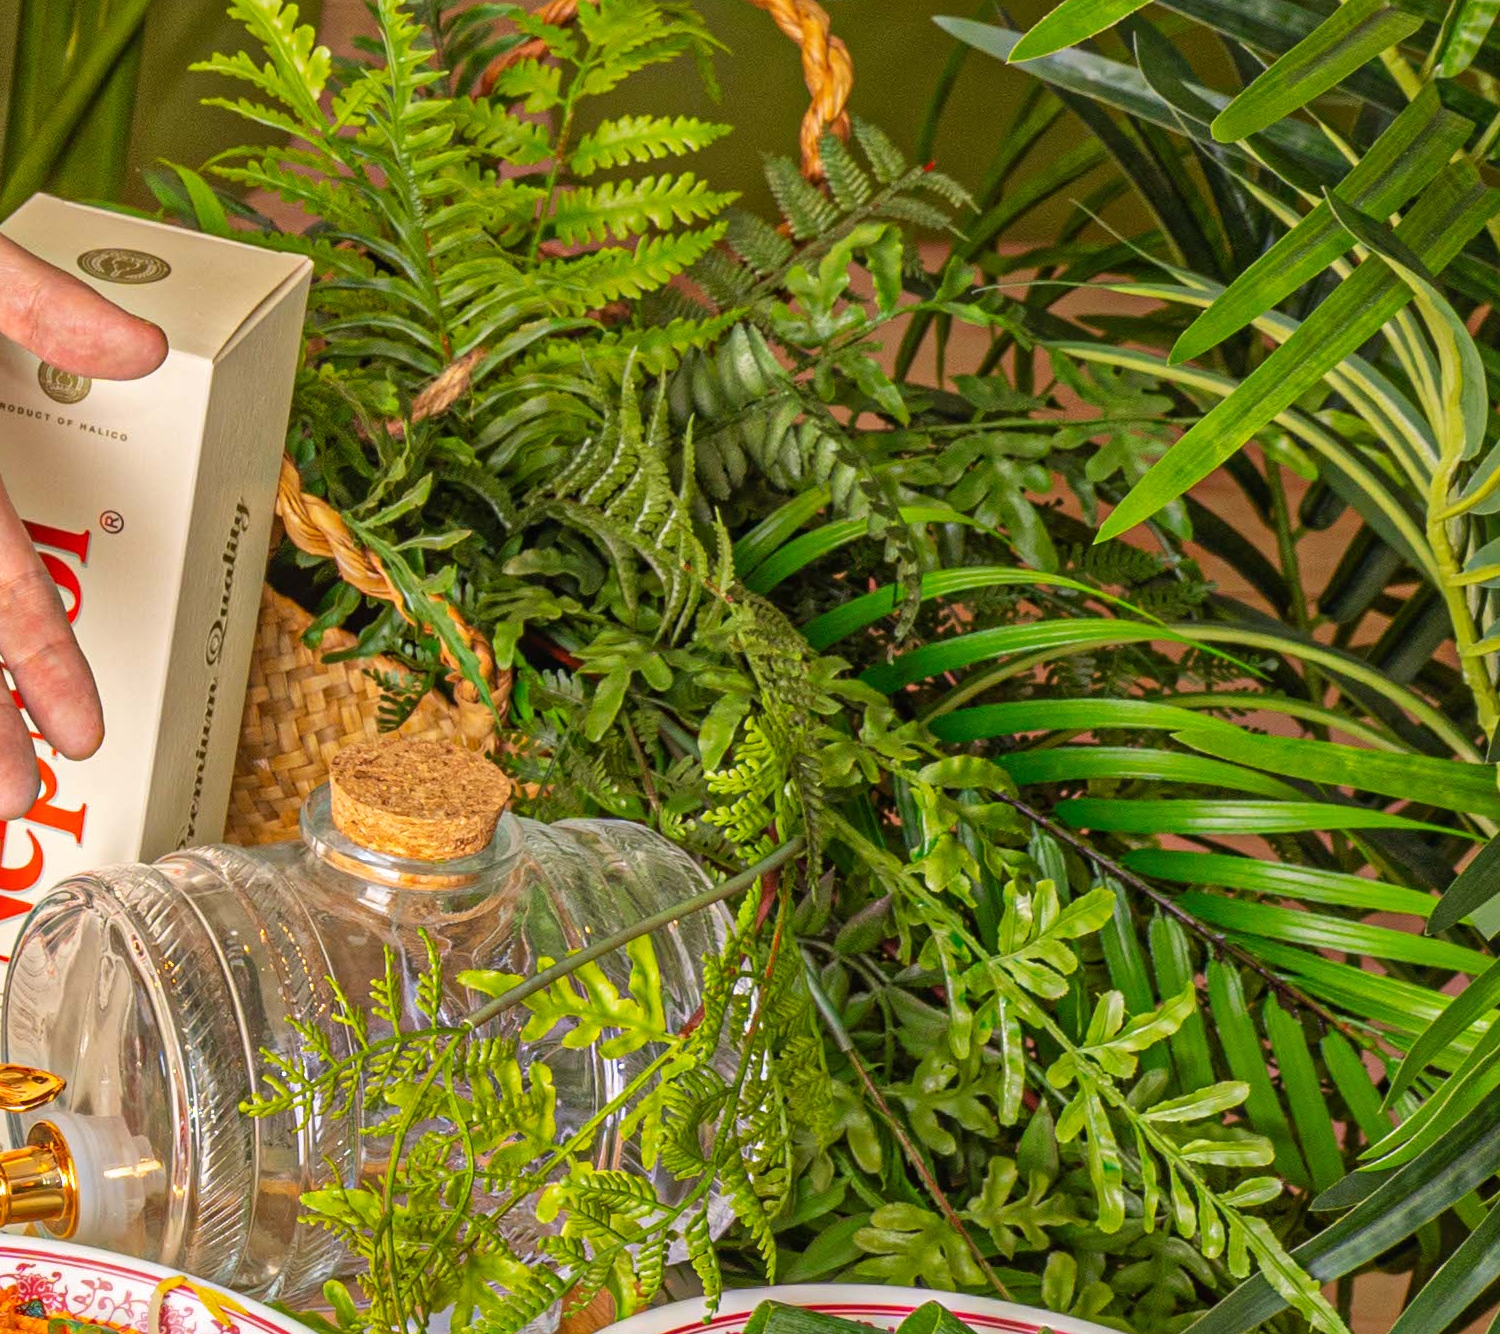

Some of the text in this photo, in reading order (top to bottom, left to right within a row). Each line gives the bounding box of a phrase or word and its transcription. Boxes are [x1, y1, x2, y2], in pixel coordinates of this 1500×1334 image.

[57, 416, 74, 428] OF
[79, 421, 128, 442] HALICO
[205, 497, 251, 666] Quality
